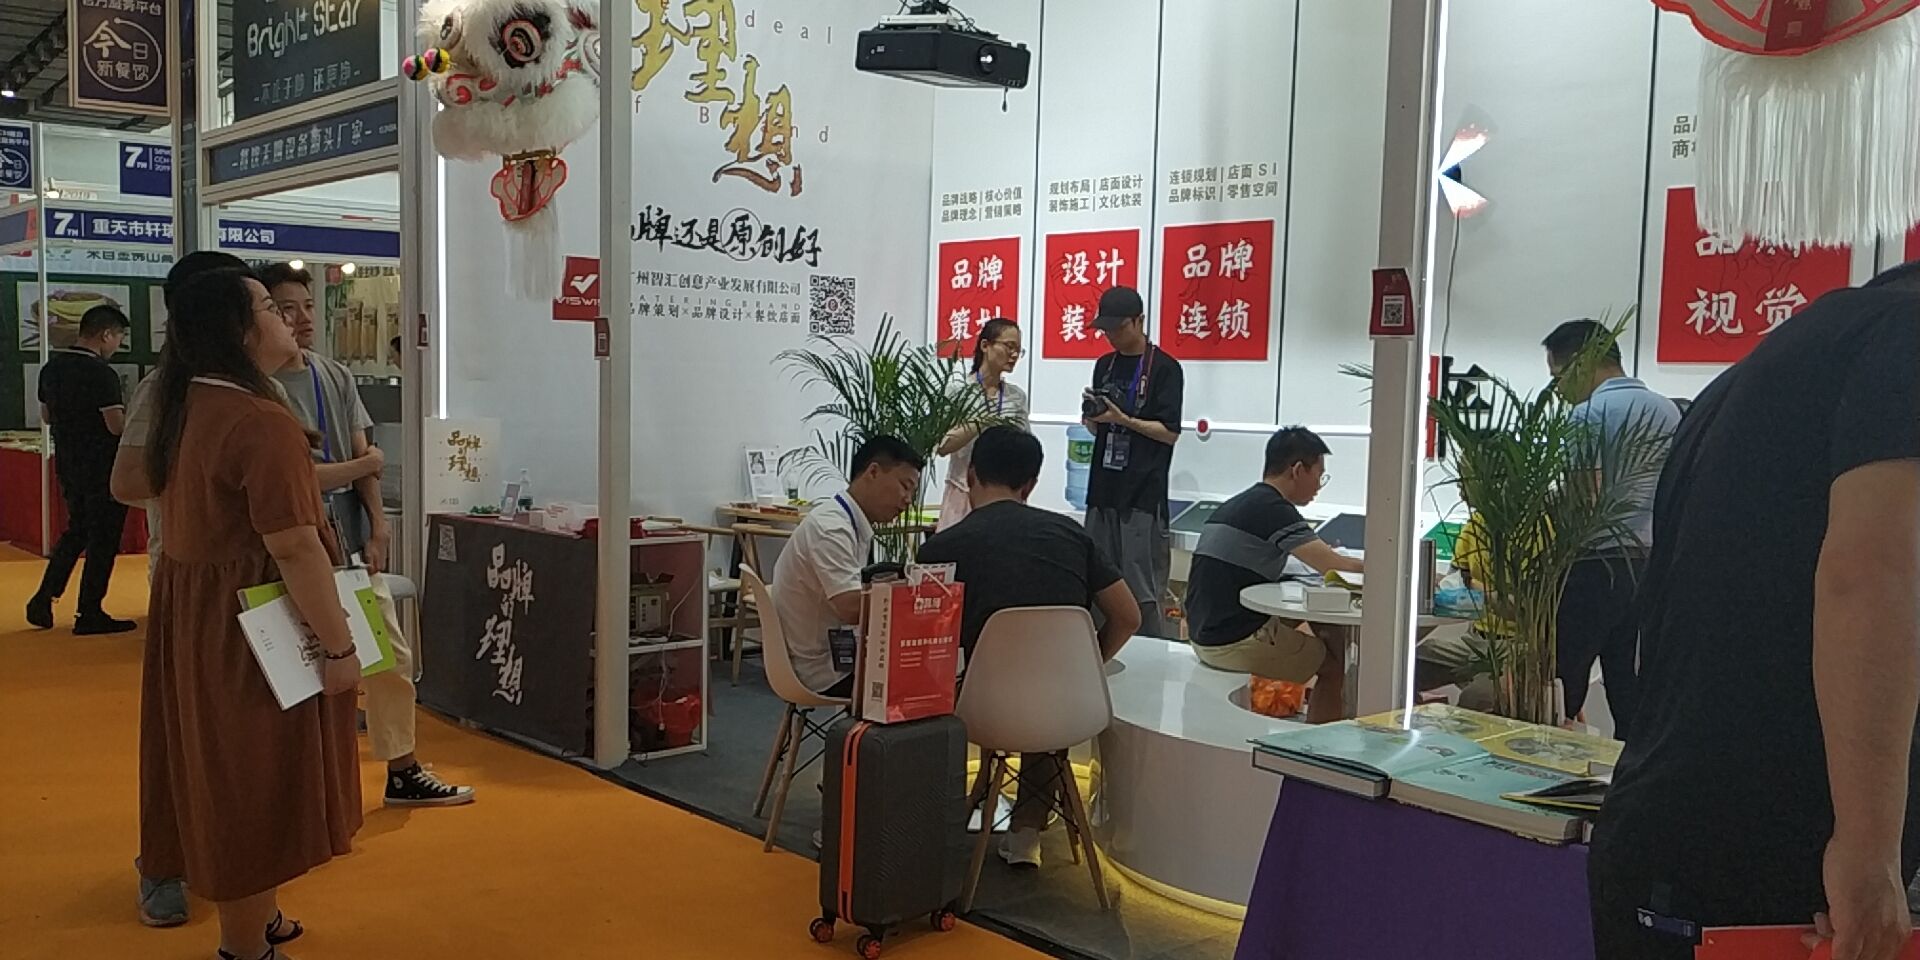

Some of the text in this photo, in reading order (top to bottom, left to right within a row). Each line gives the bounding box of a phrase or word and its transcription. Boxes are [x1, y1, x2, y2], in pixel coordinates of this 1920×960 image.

[247, 7, 309, 58] Bright
[97, 60, 149, 81] 新餐饮
[630, 204, 822, 268] 牌还是原创好
[950, 254, 1003, 291] 品牌
[1061, 248, 1125, 286] 设计
[1181, 238, 1254, 281] 品牌
[555, 296, 600, 306] VISWI
[631, 269, 801, 296] 州智汇创意产业发展有限公司
[1177, 299, 1251, 341] 连锁
[1685, 284, 1808, 336] 视觉
